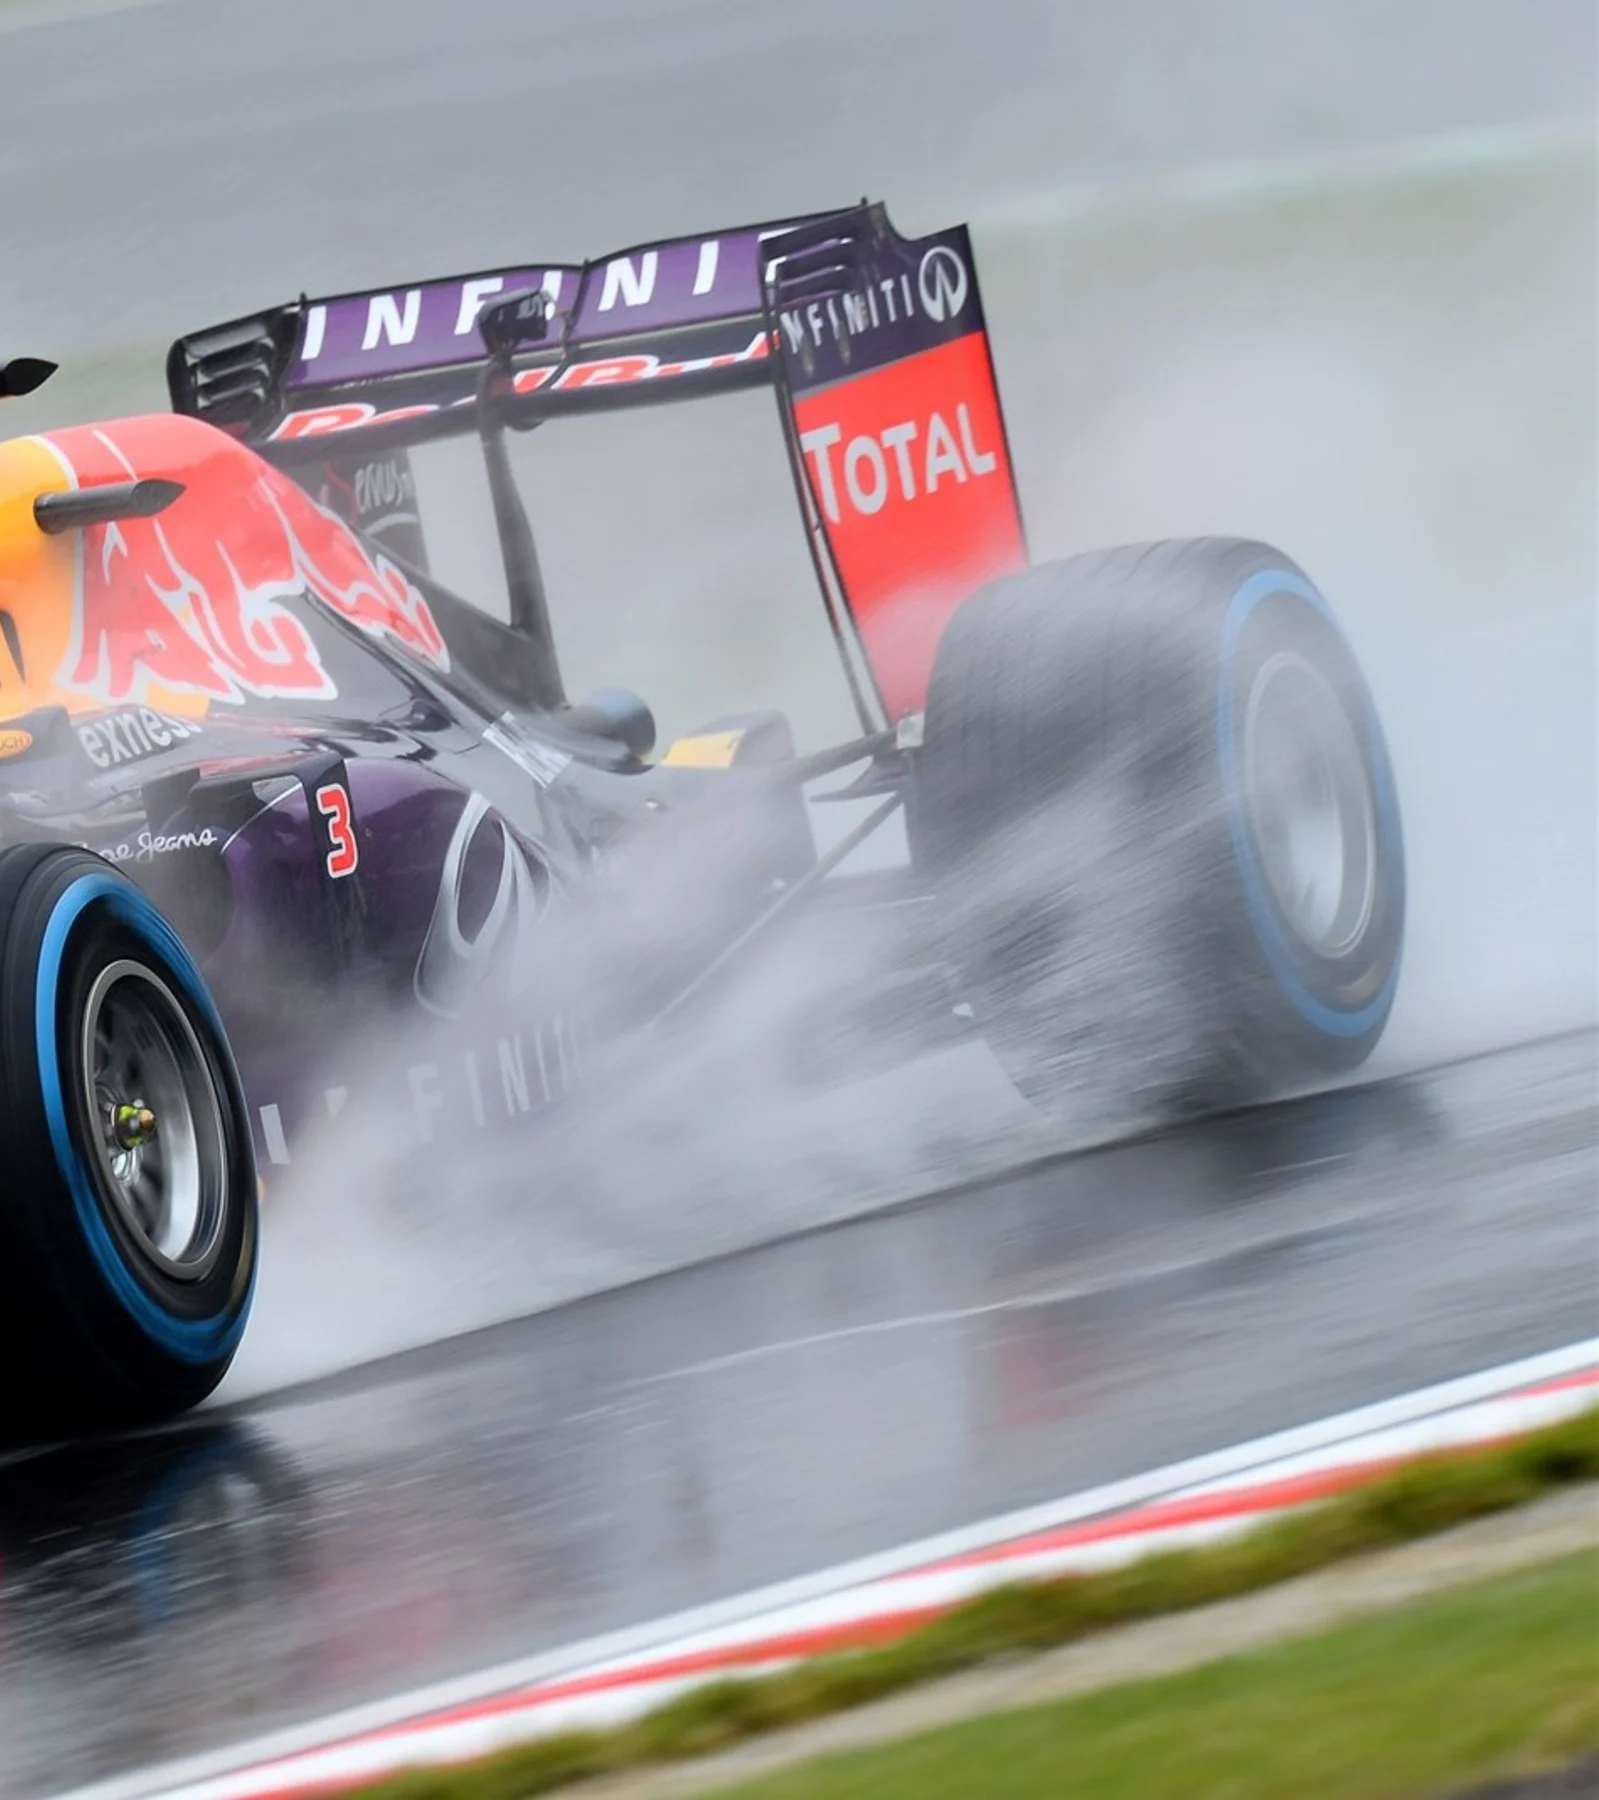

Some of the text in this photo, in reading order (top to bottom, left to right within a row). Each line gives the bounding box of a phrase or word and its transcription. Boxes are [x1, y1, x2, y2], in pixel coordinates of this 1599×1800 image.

[301, 226, 802, 361] INFINI
[779, 273, 914, 354] NFINITI
[801, 403, 996, 525] TOTAL
[77, 687, 202, 767] exnes
[317, 784, 358, 878] 3
